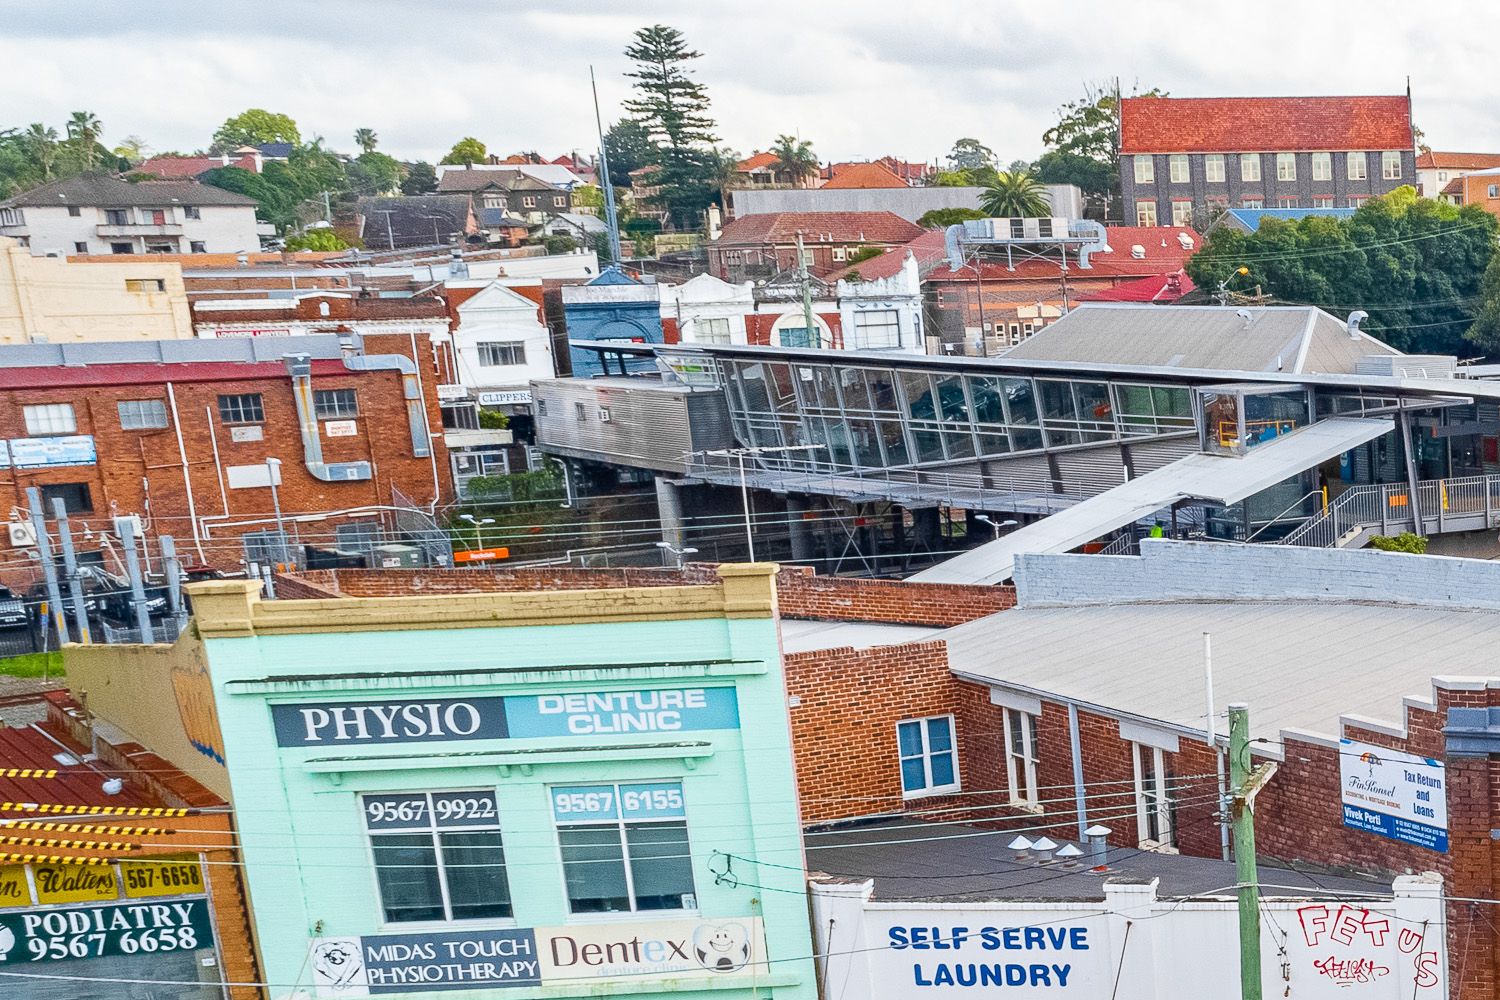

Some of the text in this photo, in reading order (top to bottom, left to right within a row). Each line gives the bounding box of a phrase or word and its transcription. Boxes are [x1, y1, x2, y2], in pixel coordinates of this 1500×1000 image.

[482, 392, 533, 403] CLIPPERS
[538, 689, 707, 714] DENTURE
[300, 702, 481, 741] PHYSIO
[568, 710, 682, 734] CLINIC
[1404, 770, 1441, 789] Tax Return
[556, 789, 683, 813] 9567 6155
[1416, 790, 1429, 802] and
[368, 798, 495, 822] 9567 9922
[1344, 806, 1363, 820] Vivek
[1413, 803, 1434, 818] Loans
[37, 865, 114, 893] Walters
[22, 903, 194, 937] PODIATRY
[28, 926, 198, 961] 9567 6658
[889, 926, 1089, 950] SELF SERVE
[368, 938, 531, 963] MIDAS TOUCH
[550, 935, 692, 967] Dentex
[368, 959, 538, 985] PHYSIOTHERAPY
[914, 963, 1071, 987] LAUNDRY
